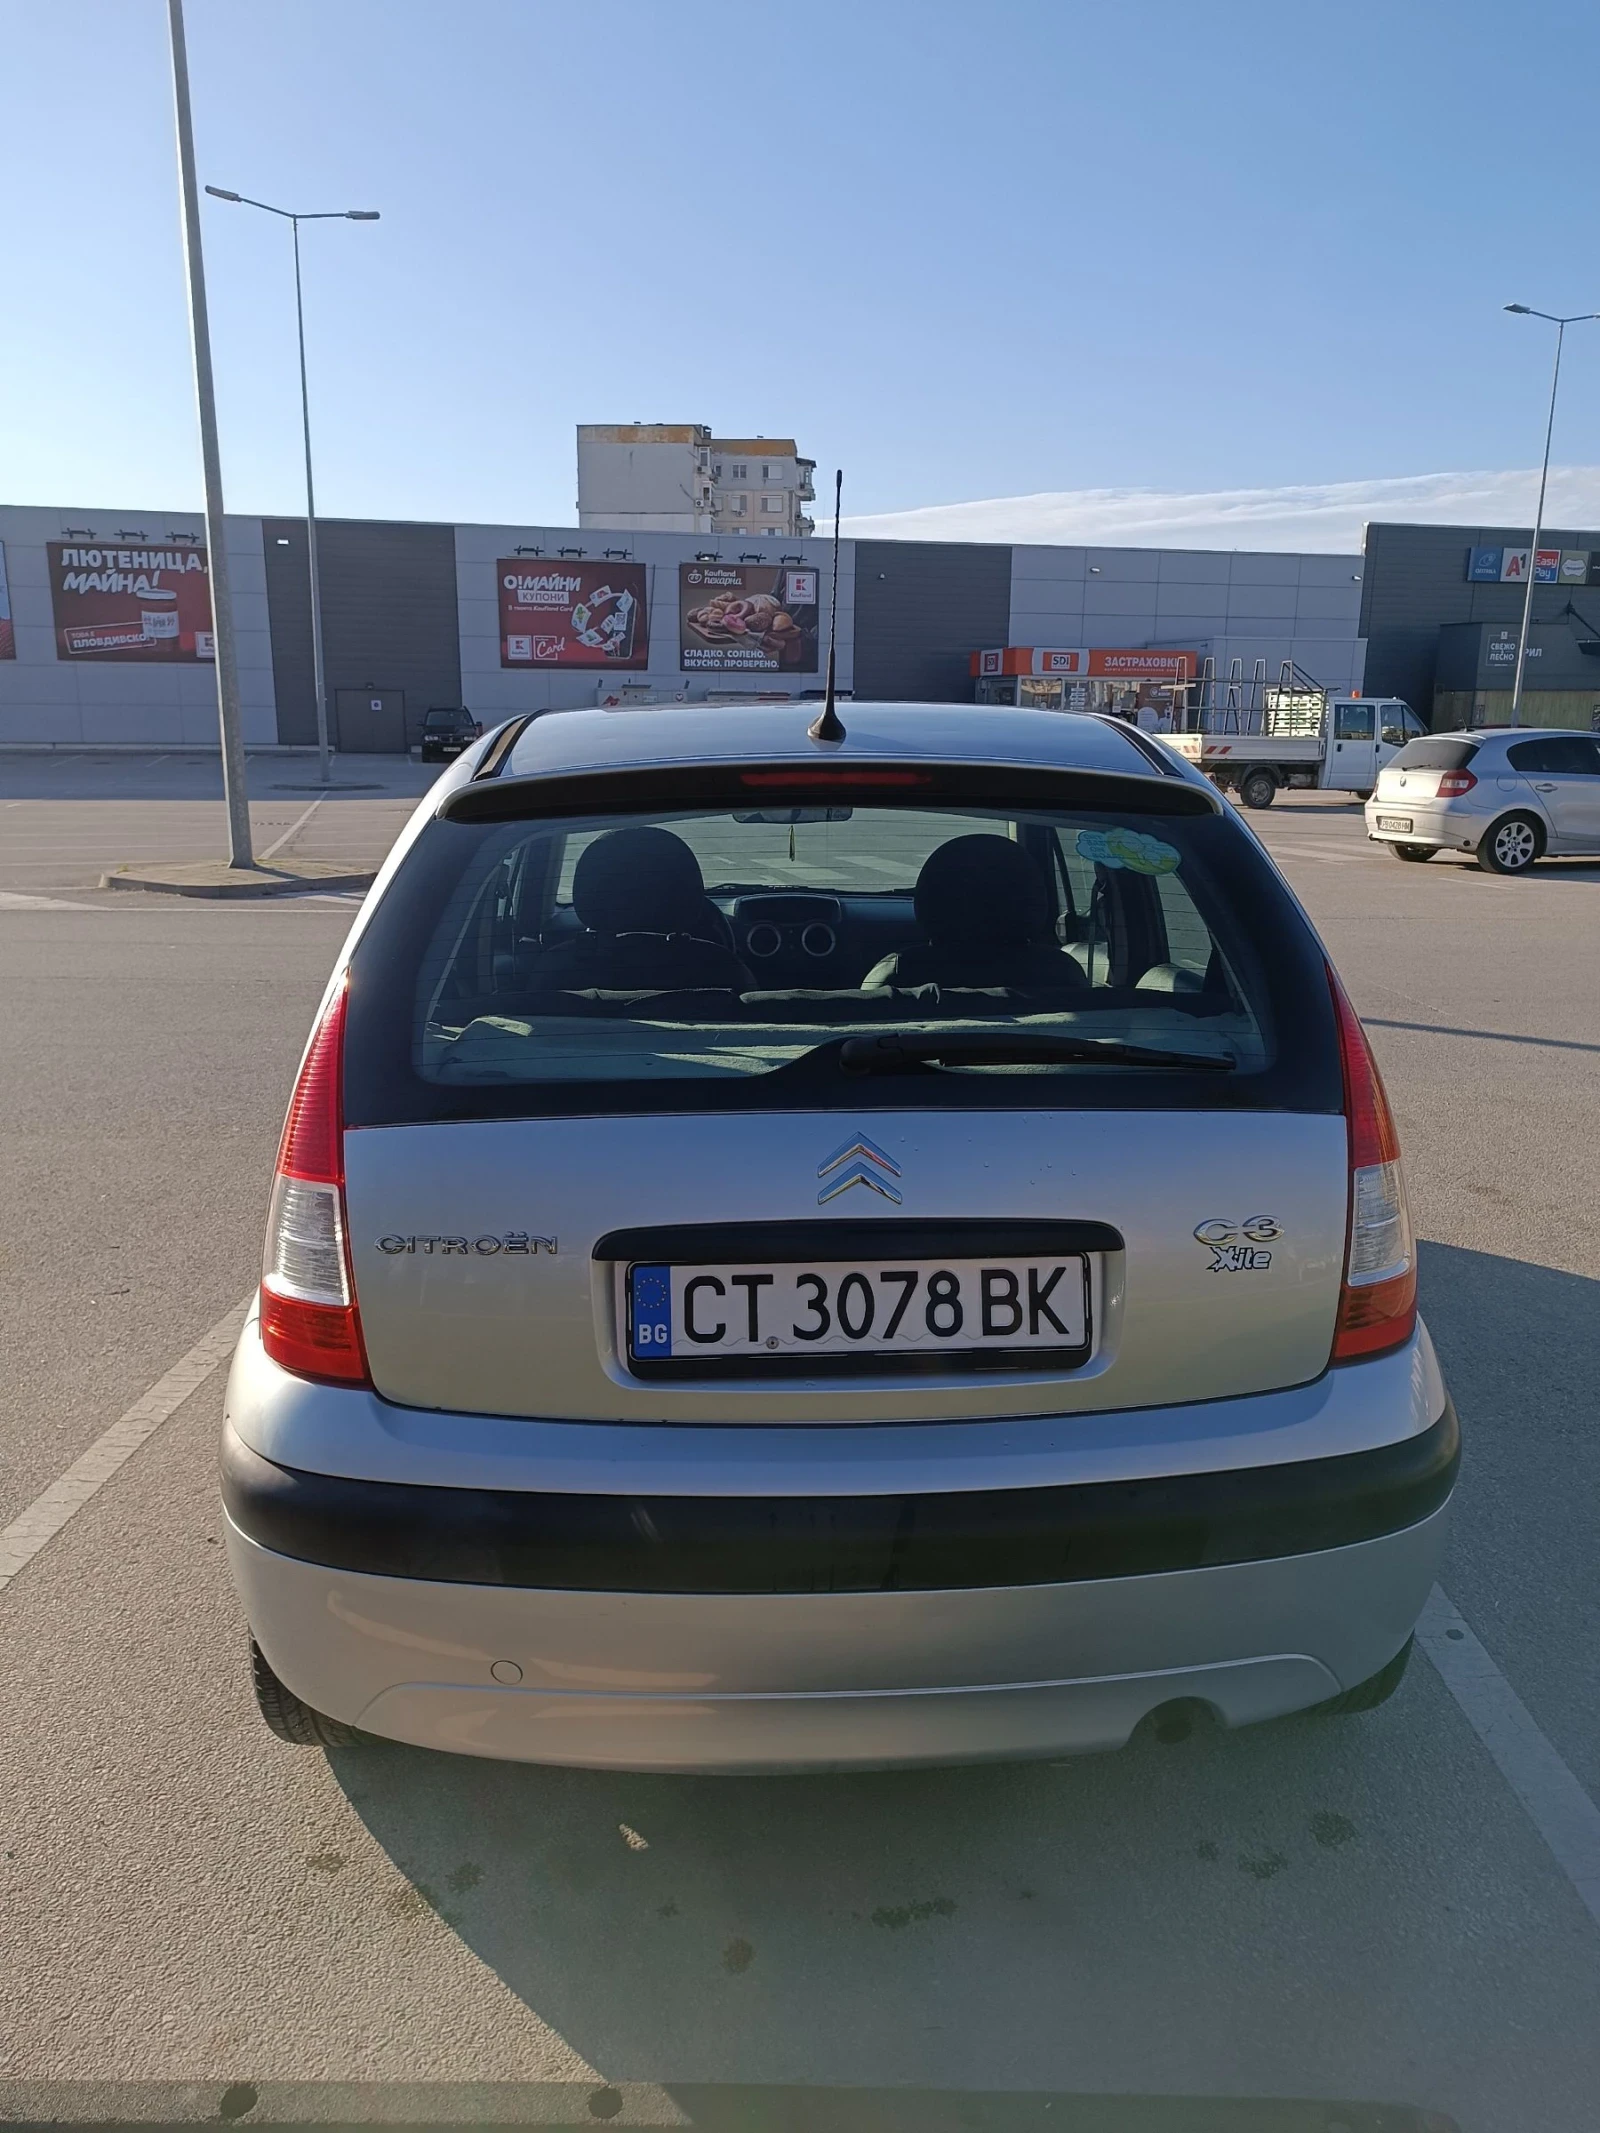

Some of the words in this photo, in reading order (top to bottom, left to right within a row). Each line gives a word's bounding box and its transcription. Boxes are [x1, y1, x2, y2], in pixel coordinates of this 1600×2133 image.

[61, 548, 208, 574] ЛЮТЕНИЦА,
[1505, 553, 1526, 577] A1
[1535, 556, 1558, 568] Easy
[704, 569, 736, 577] Kaufland
[1535, 568, 1551, 580] Pay
[63, 568, 161, 595] МАЙНА!
[522, 592, 565, 601] КУПОНИ
[537, 636, 566, 657] Card
[1490, 642, 1516, 651] СВЕЖО
[1524, 648, 1543, 657] РИЛ
[684, 649, 725, 659] СЛАДКО.
[727, 650, 766, 659] СОЛЕНО.
[1052, 655, 1069, 665] SDI
[1489, 653, 1515, 661] ЛЕСНО
[684, 659, 722, 668] ВКУСНО.
[724, 659, 780, 669] ПРОВЕРЕНО.
[1193, 1214, 1285, 1246] C3
[374, 1231, 558, 1256] CITROËN
[683, 1273, 775, 1344] CT
[792, 1269, 964, 1341] 3078
[981, 1265, 1070, 1337] BK
[638, 1323, 668, 1345] BG
